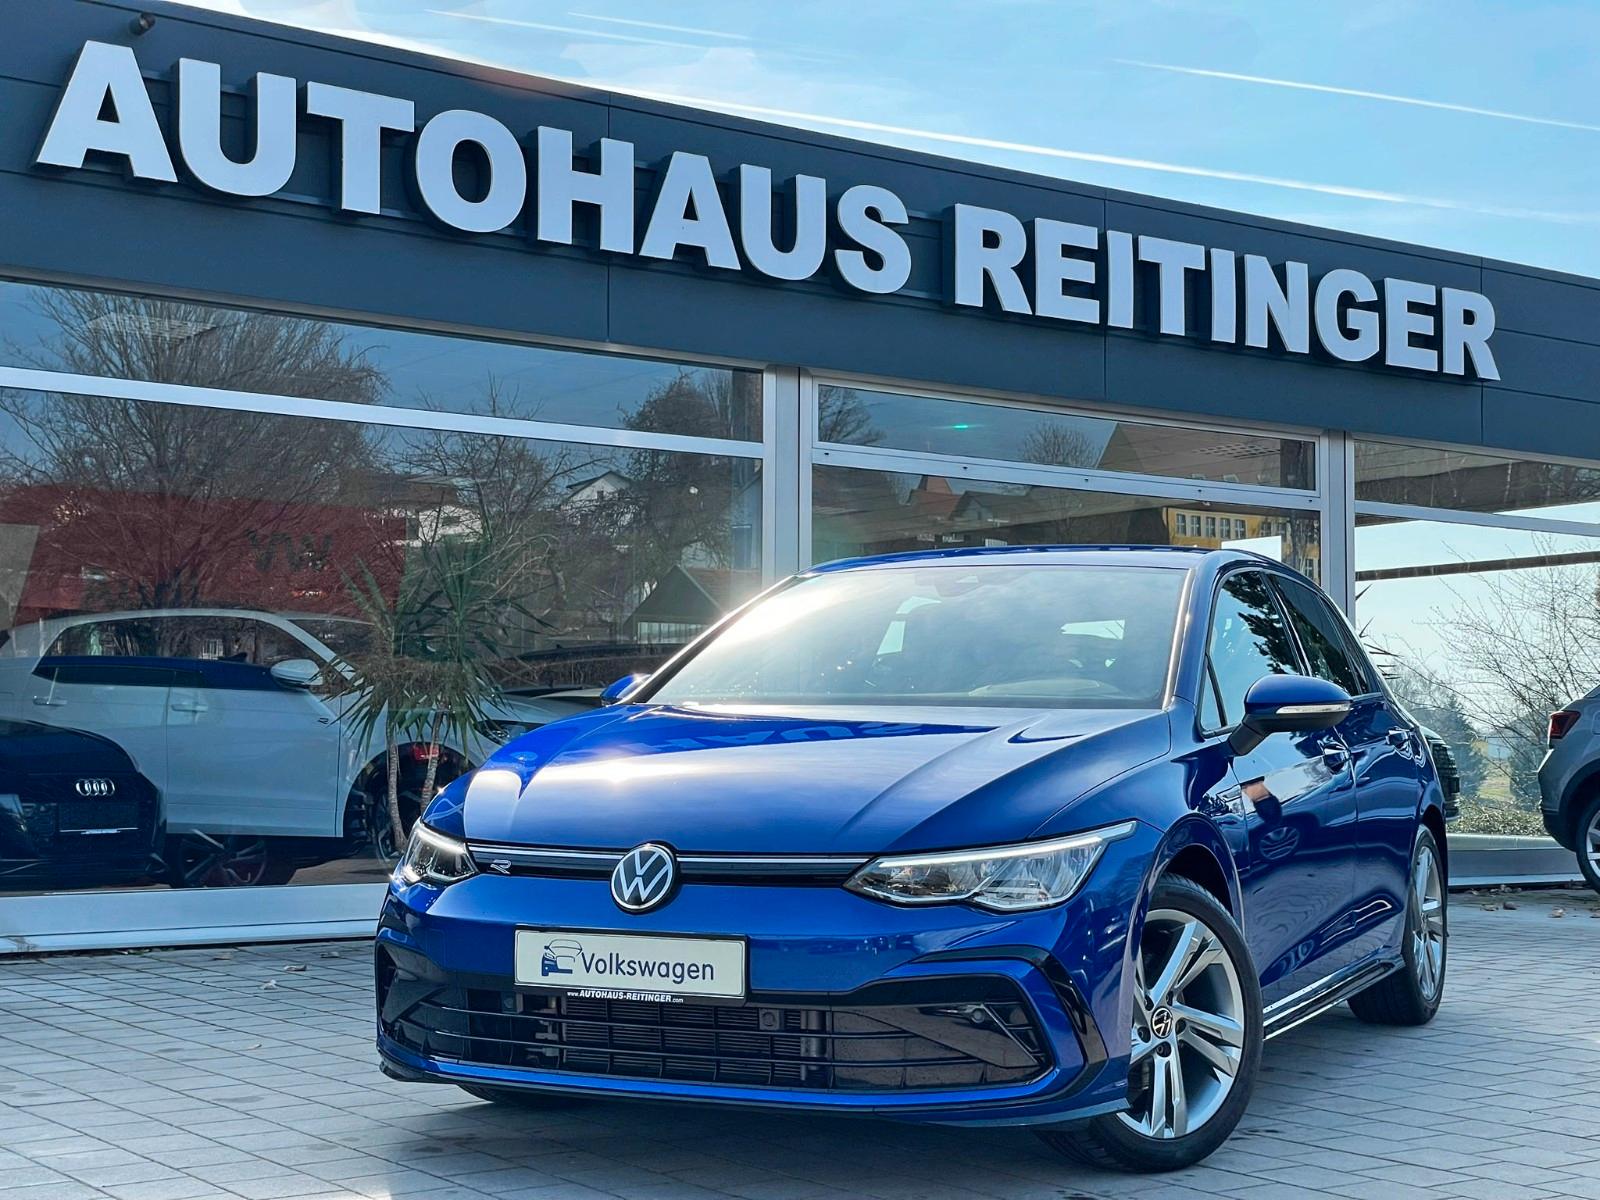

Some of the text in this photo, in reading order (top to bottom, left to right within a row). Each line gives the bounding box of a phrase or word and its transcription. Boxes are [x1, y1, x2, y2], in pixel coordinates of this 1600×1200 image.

[36, 40, 1501, 381] AUTOHAUS REITINGER
[581, 952, 714, 984] Volkswagen
[566, 989, 684, 1003] www.AUTOHAUS-REITINGER.com
